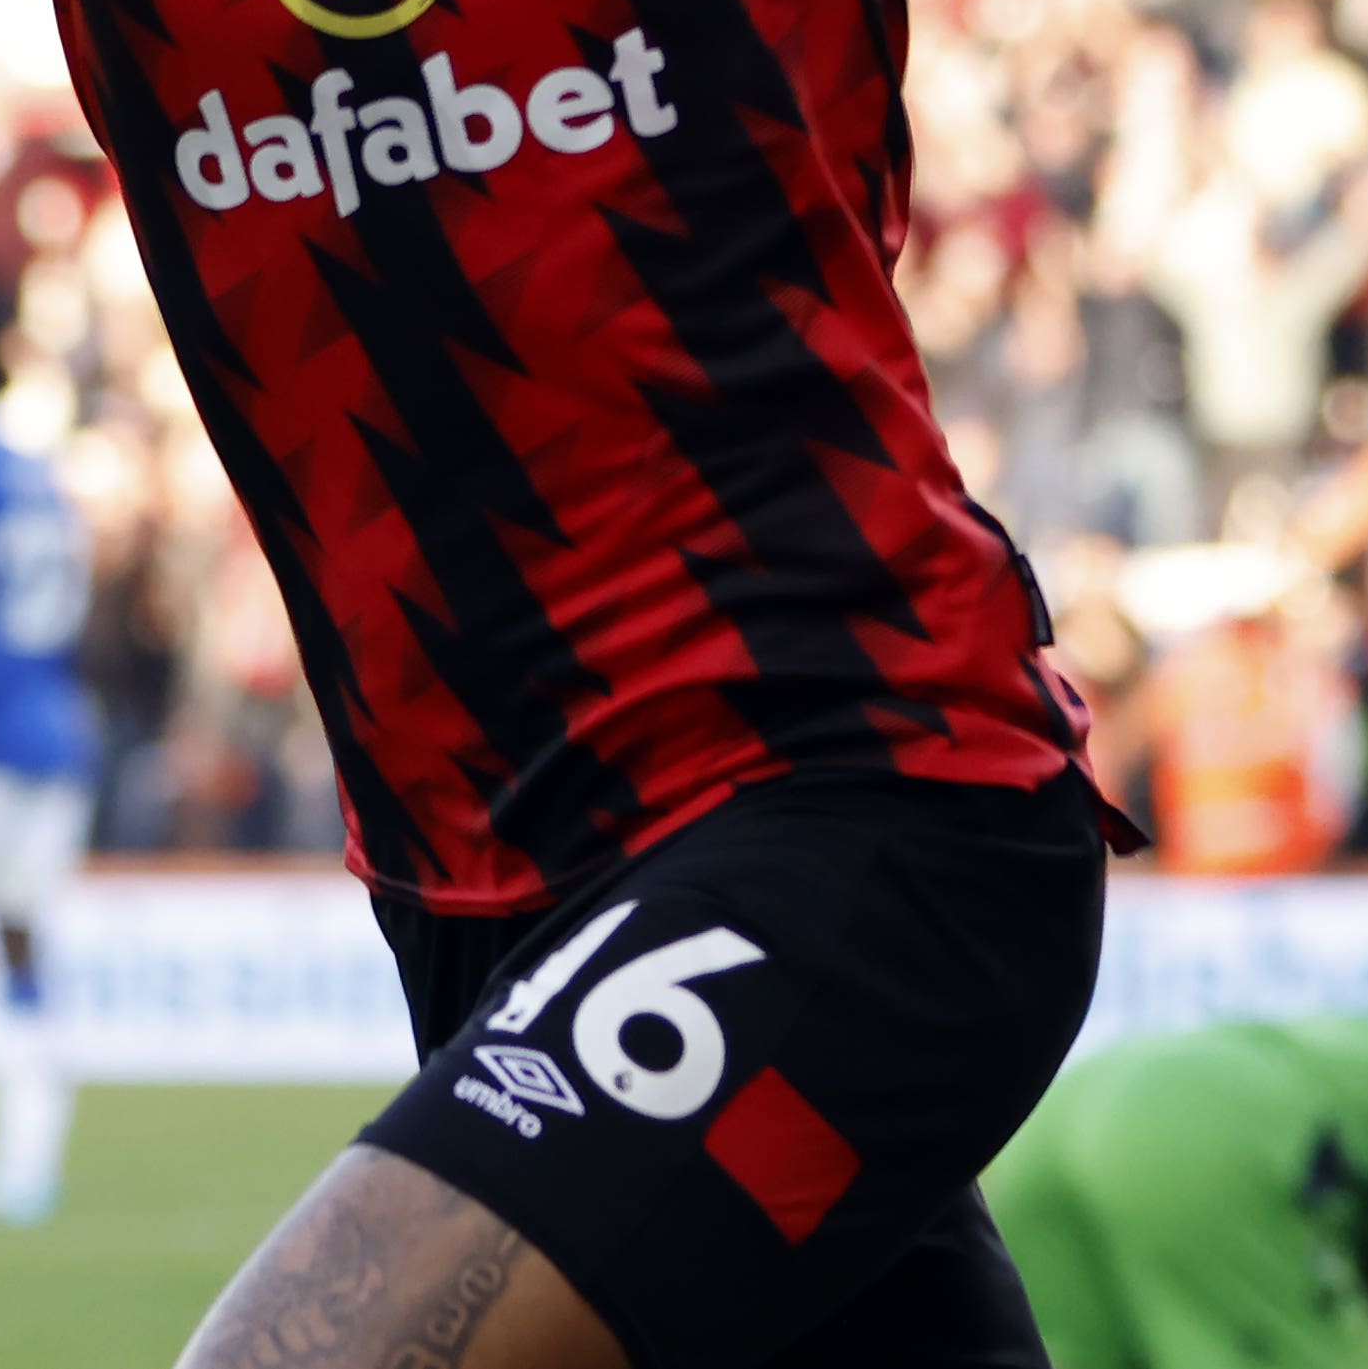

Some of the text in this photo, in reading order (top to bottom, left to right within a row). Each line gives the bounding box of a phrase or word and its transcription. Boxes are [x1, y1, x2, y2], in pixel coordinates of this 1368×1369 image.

[174, 26, 678, 219] dafabet
[486, 898, 767, 1120] 16
[452, 1074, 543, 1140] umbro
